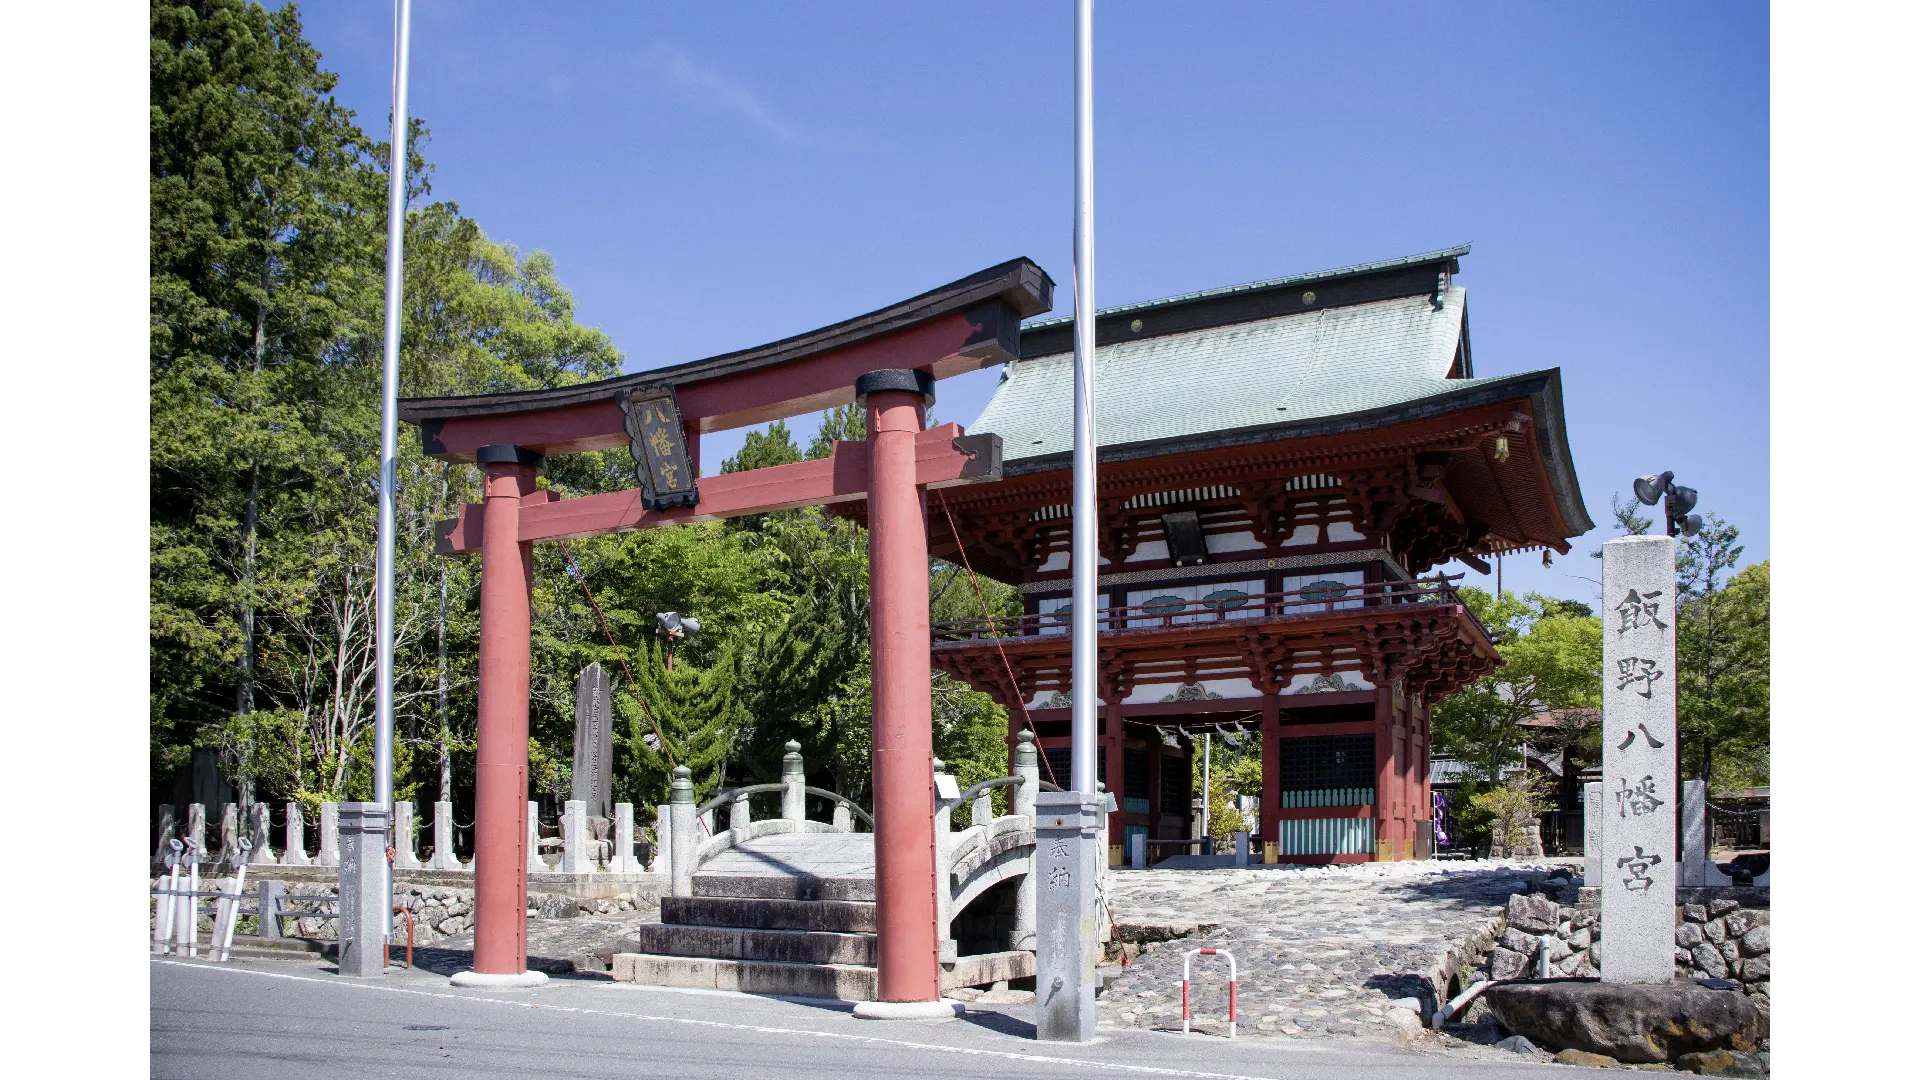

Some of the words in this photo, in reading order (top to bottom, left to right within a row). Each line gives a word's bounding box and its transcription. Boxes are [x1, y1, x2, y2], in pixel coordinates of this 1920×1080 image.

[645, 403, 677, 489] 八幡宮
[1613, 588, 1669, 892] 飯野八幡宮
[1049, 836, 1071, 890] 奉納
